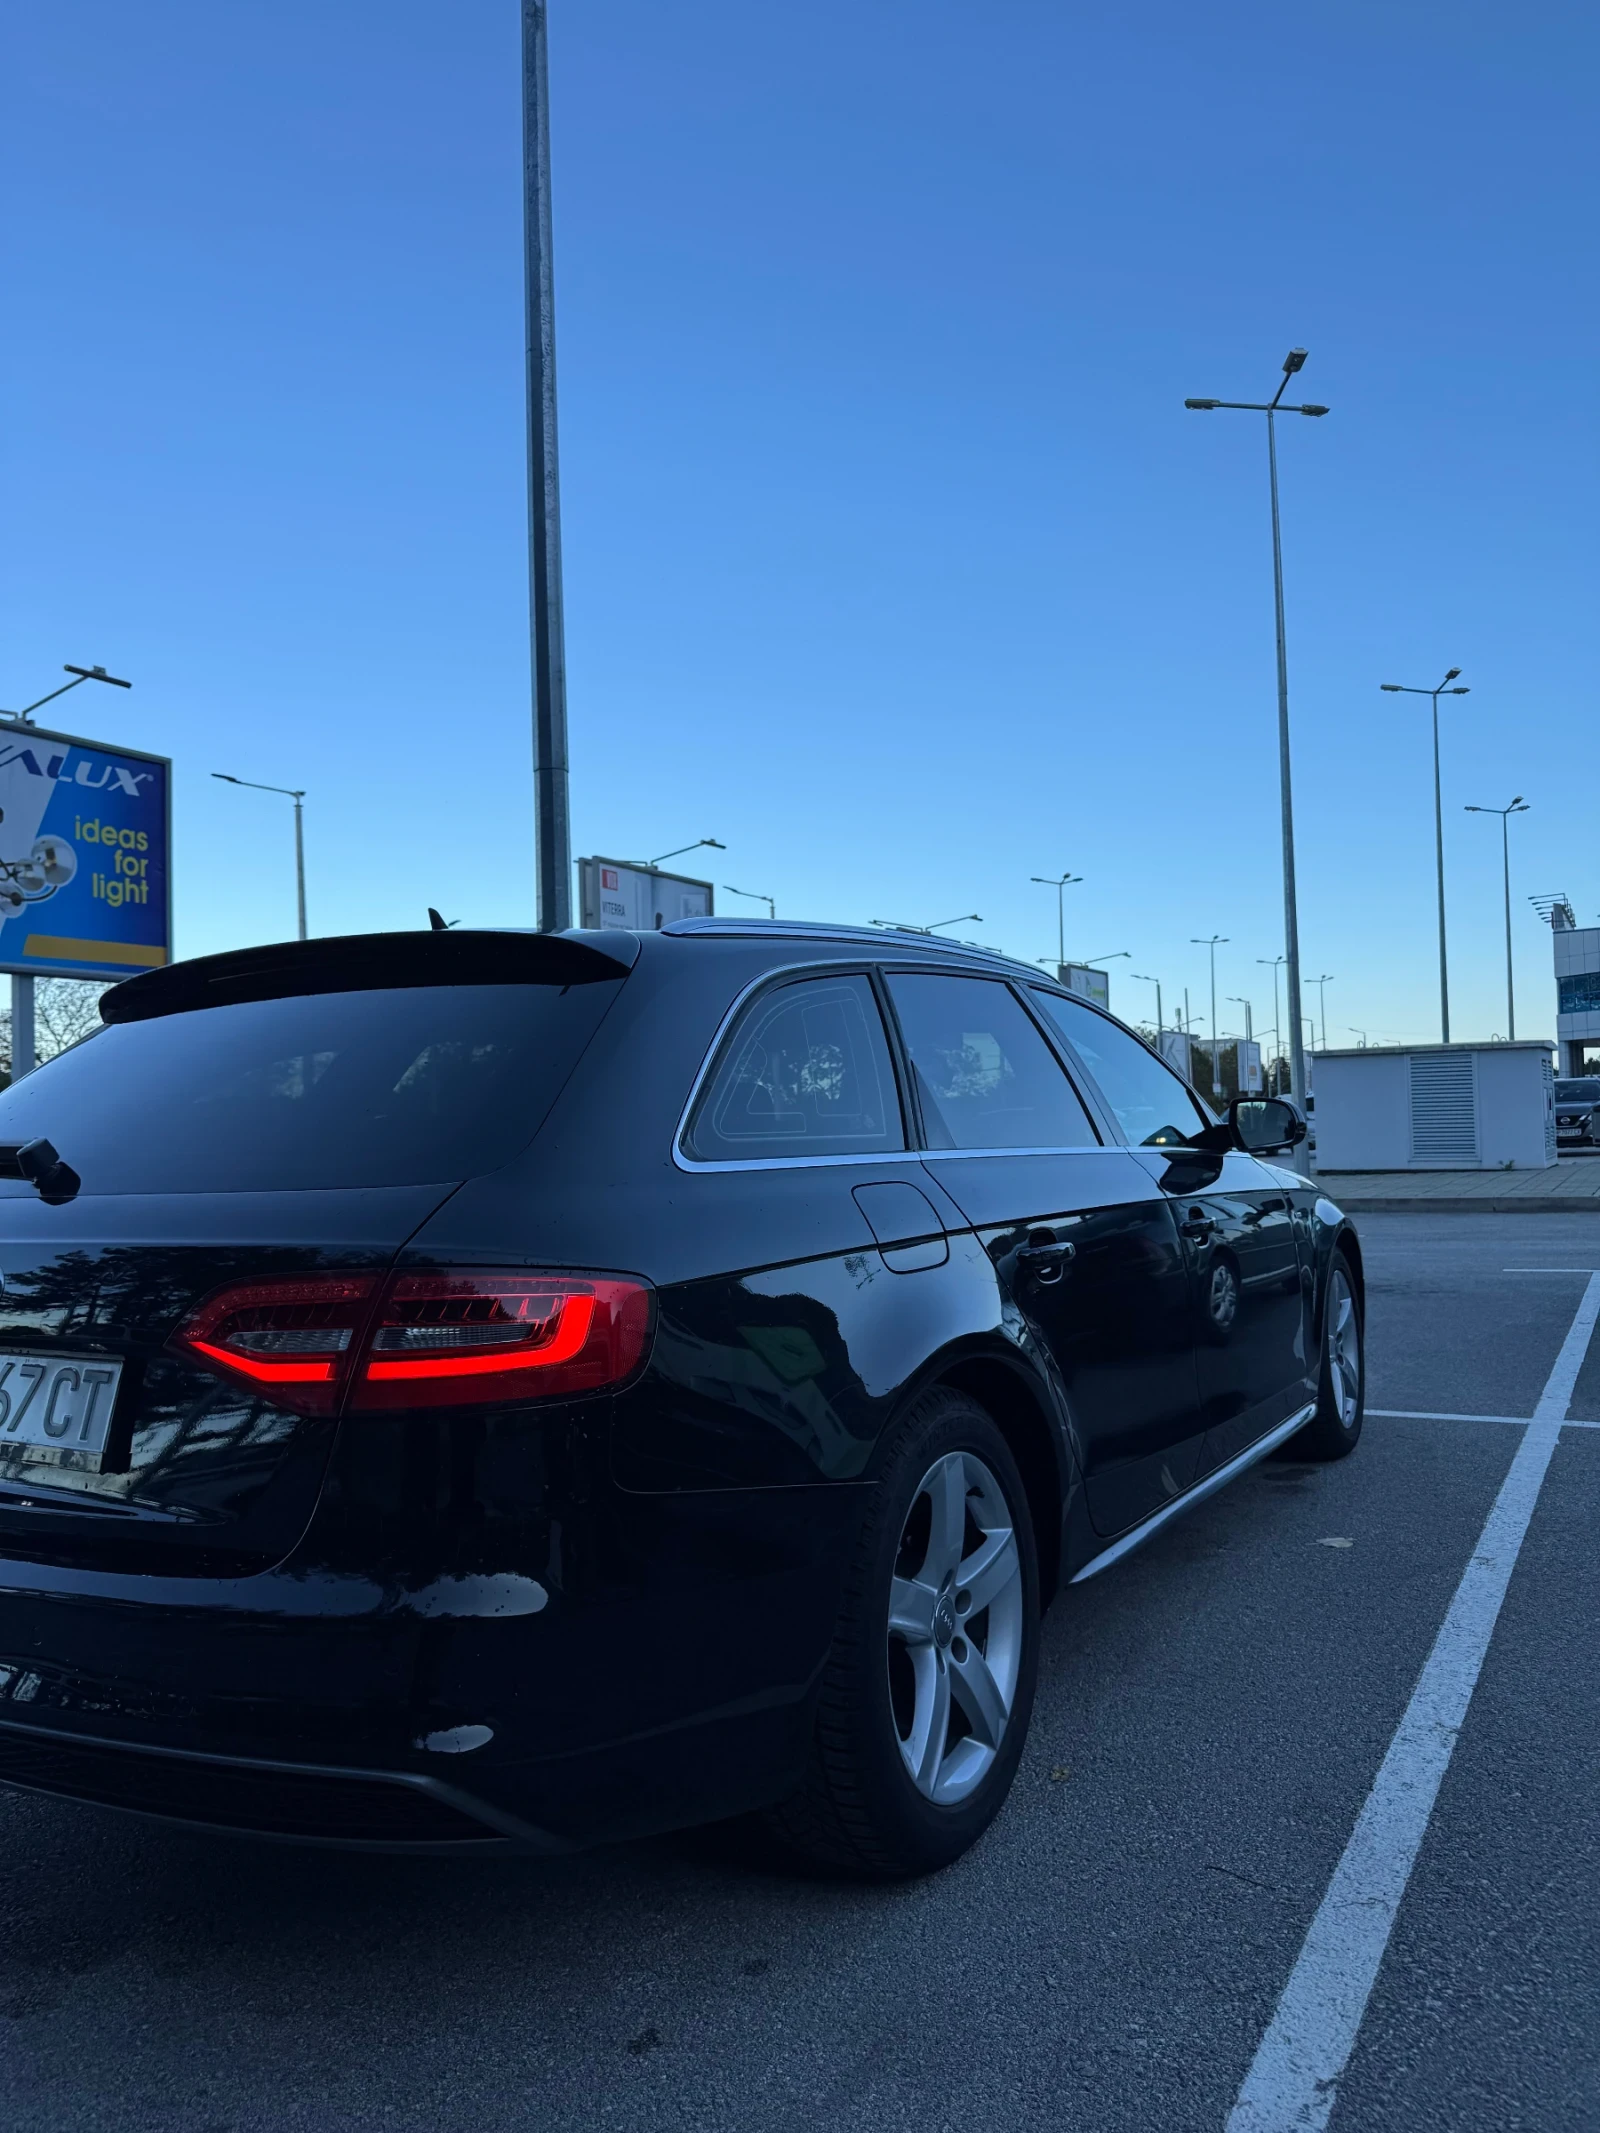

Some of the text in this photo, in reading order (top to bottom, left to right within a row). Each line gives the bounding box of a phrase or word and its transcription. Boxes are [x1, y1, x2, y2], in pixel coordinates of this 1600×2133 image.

[0, 744, 147, 797] ALUX
[75, 815, 149, 852] ideas
[114, 849, 149, 878] for
[92, 873, 149, 907] light
